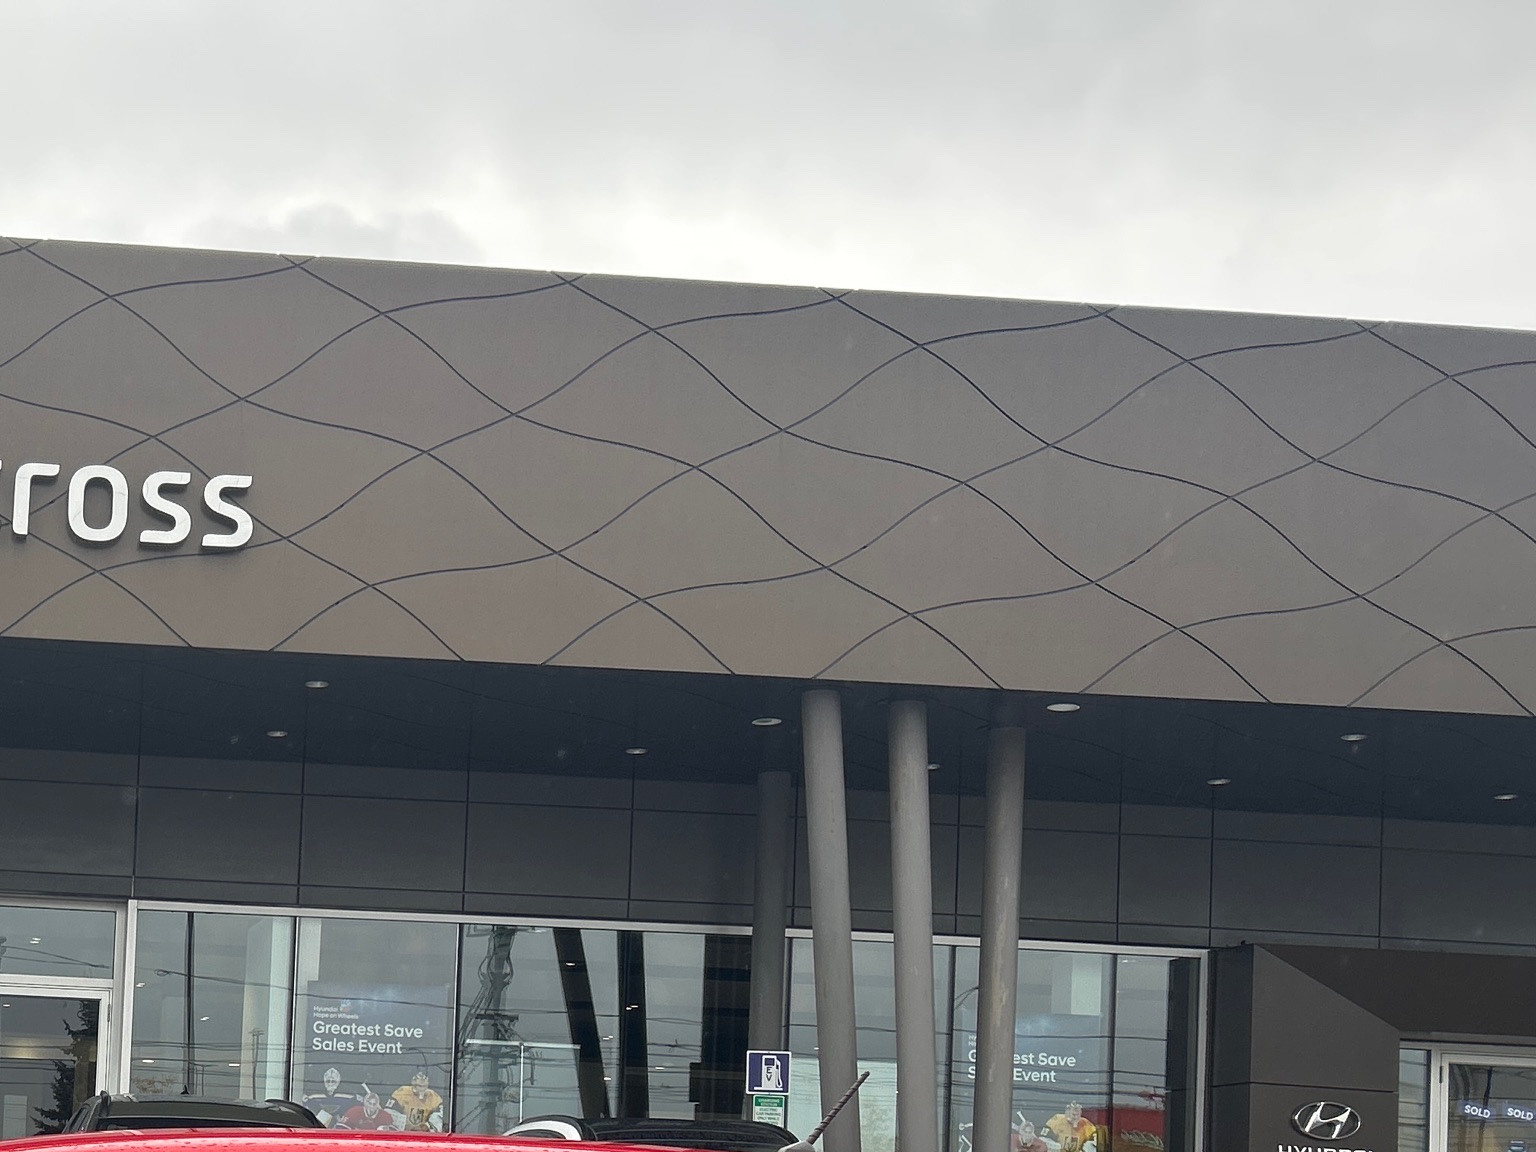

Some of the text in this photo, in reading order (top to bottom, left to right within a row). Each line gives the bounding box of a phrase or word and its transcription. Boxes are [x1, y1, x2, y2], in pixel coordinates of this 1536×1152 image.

[313, 1005, 338, 1013] Hyundai
[313, 1011, 329, 1019] Hope
[313, 1020, 424, 1038] Greatest Save
[312, 1037, 403, 1054] Sales Event
[1038, 1052, 1077, 1067] Save
[1013, 1067, 1057, 1082] Event
[1464, 1104, 1491, 1119] SOLD
[1507, 1107, 1534, 1121] SOLD
